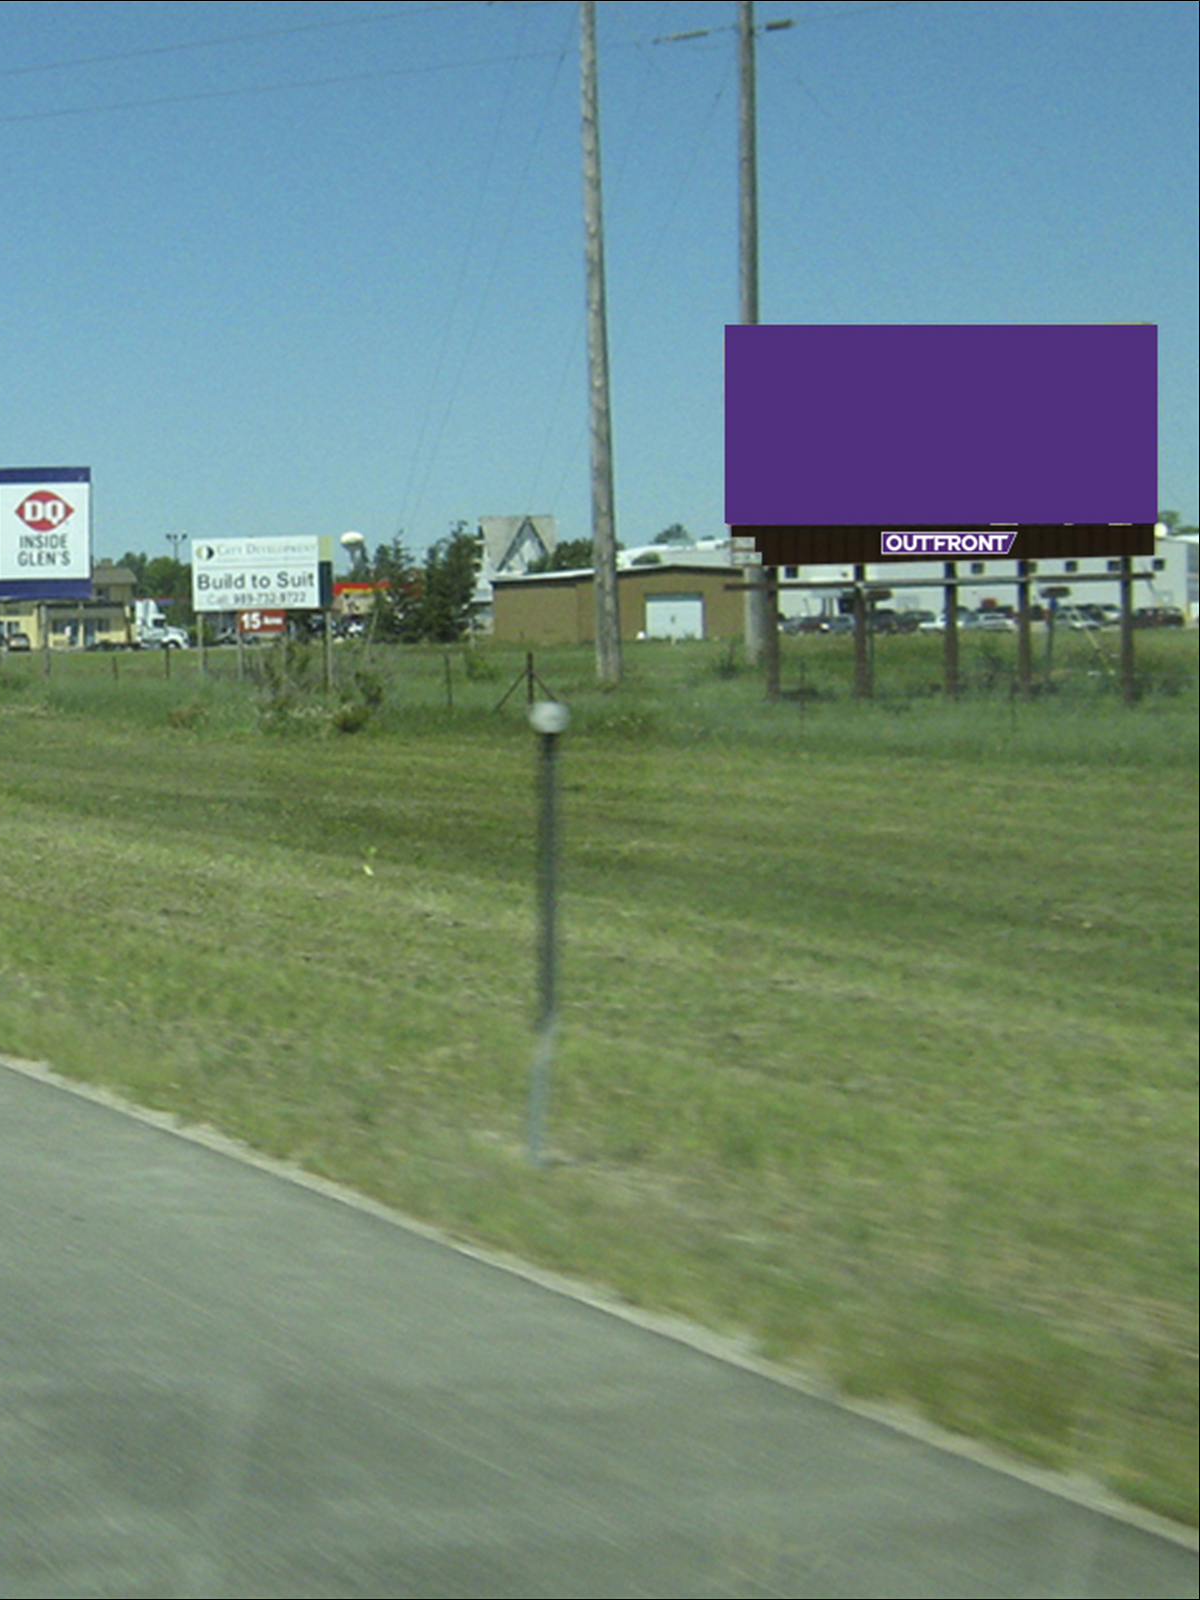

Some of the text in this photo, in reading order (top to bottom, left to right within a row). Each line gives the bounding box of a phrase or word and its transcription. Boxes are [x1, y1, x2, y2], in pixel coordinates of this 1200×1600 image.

[23, 500, 65, 525] DQ
[19, 533, 68, 550] INSIDE
[886, 534, 1009, 551] OUTFRONT
[17, 550, 72, 567] GLEN'S
[197, 571, 315, 591] Build to Suit
[241, 611, 261, 630] 15
